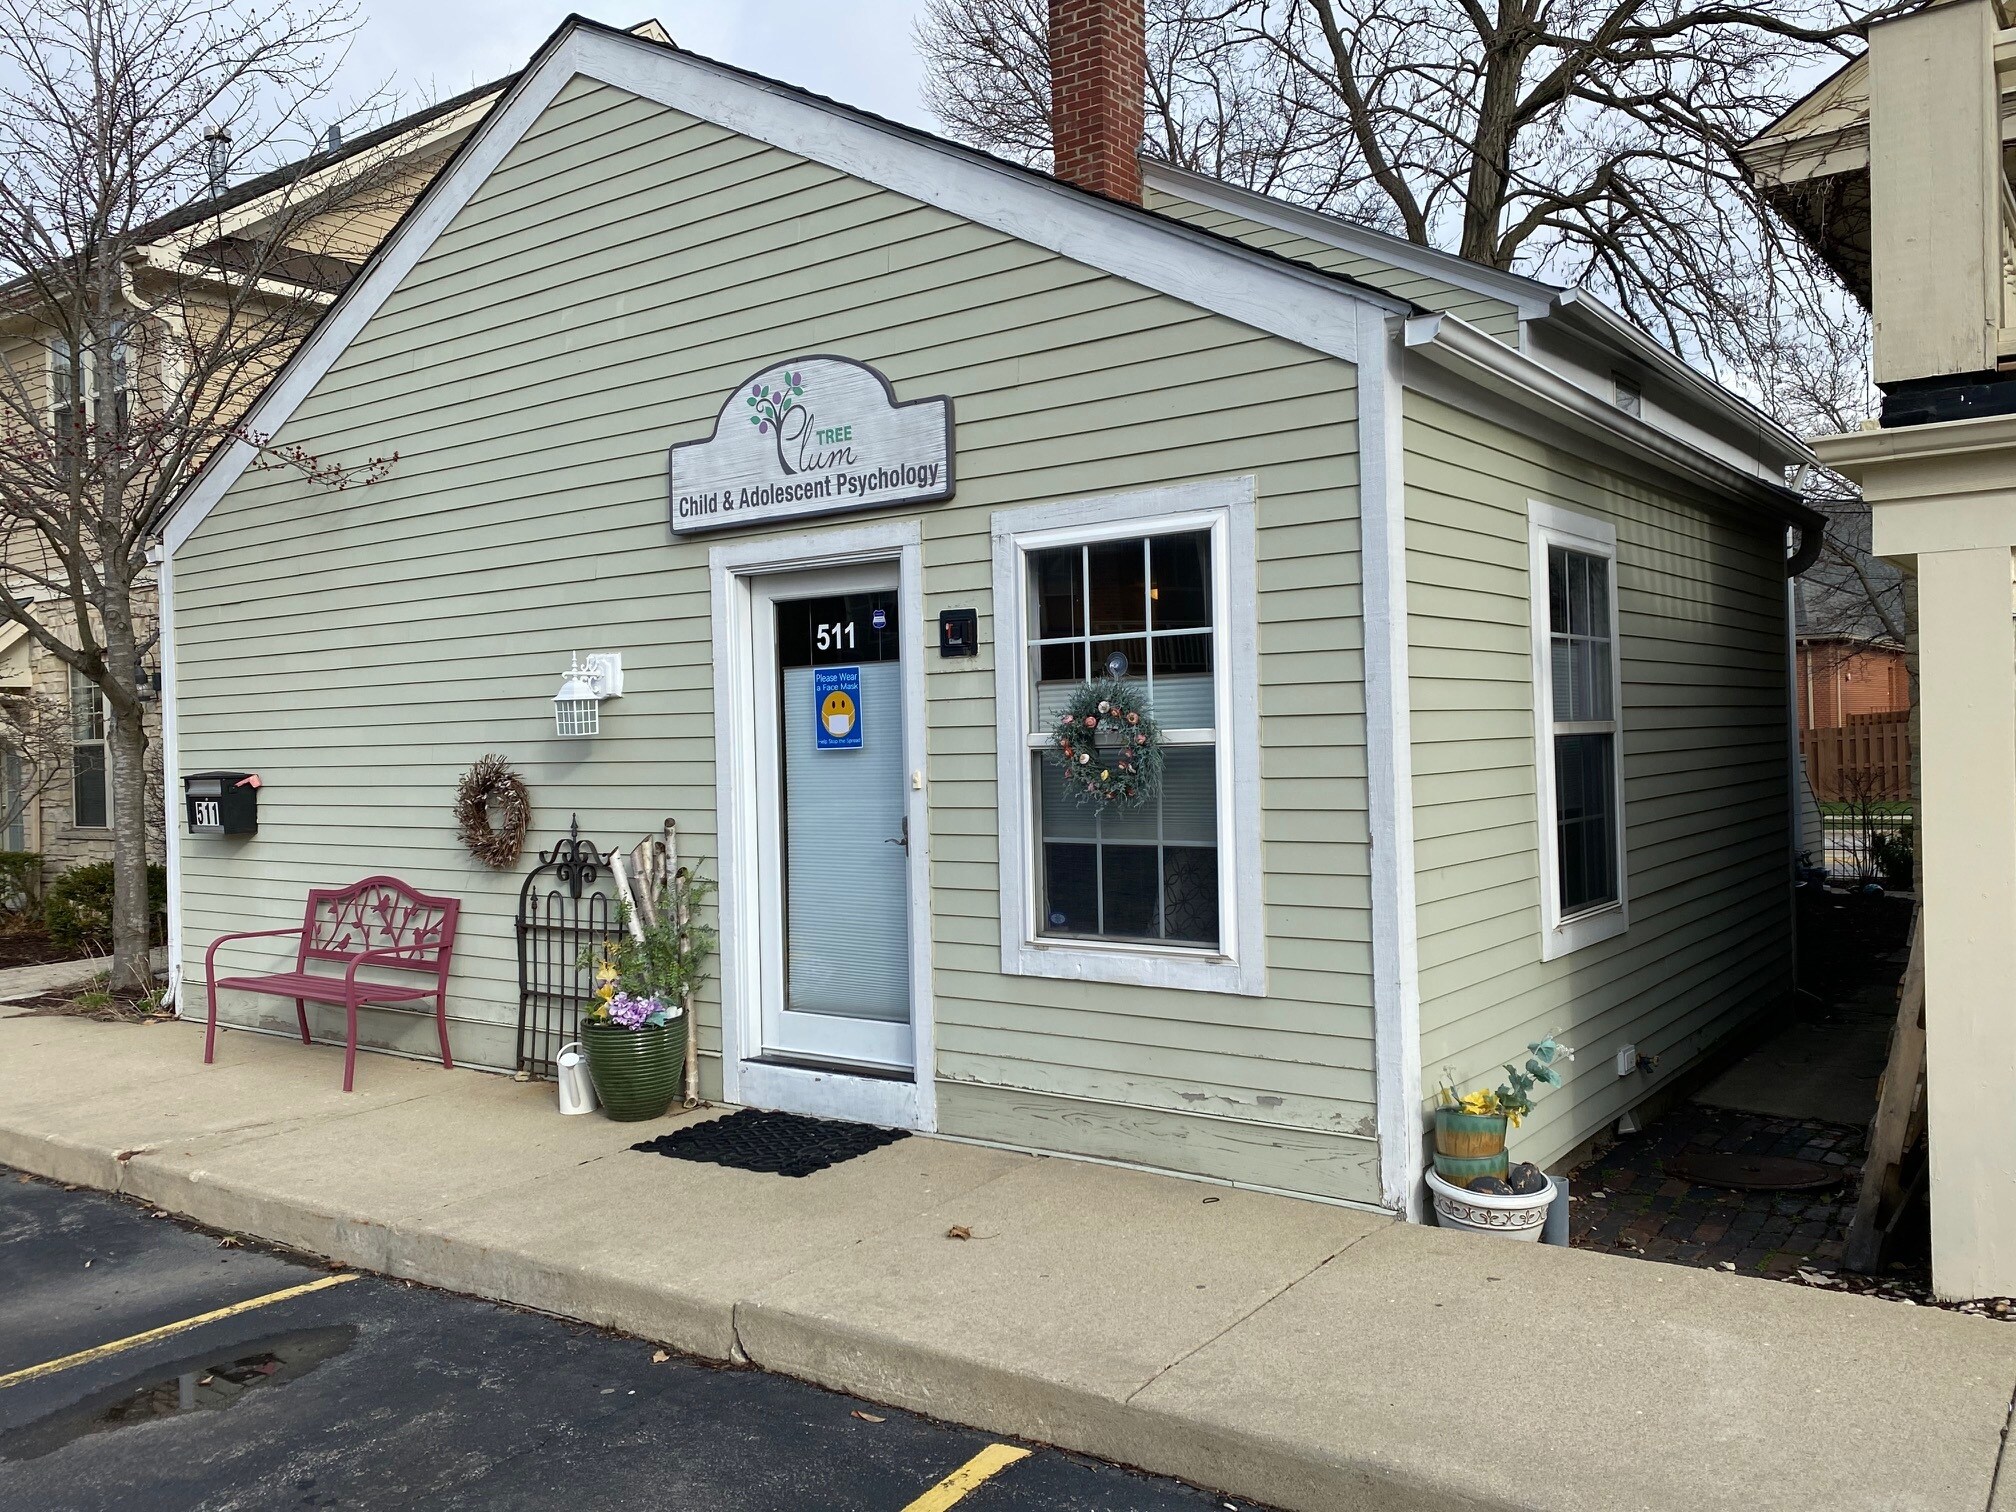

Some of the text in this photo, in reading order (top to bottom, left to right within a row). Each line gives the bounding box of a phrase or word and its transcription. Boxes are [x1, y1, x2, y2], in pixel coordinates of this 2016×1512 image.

[816, 425, 852, 446] TREE
[679, 462, 939, 518] Child & Adolescent Psychology
[816, 621, 855, 651] 511
[816, 672, 858, 682] Please Wear
[840, 682, 859, 690] Mask
[196, 802, 218, 825] 511
